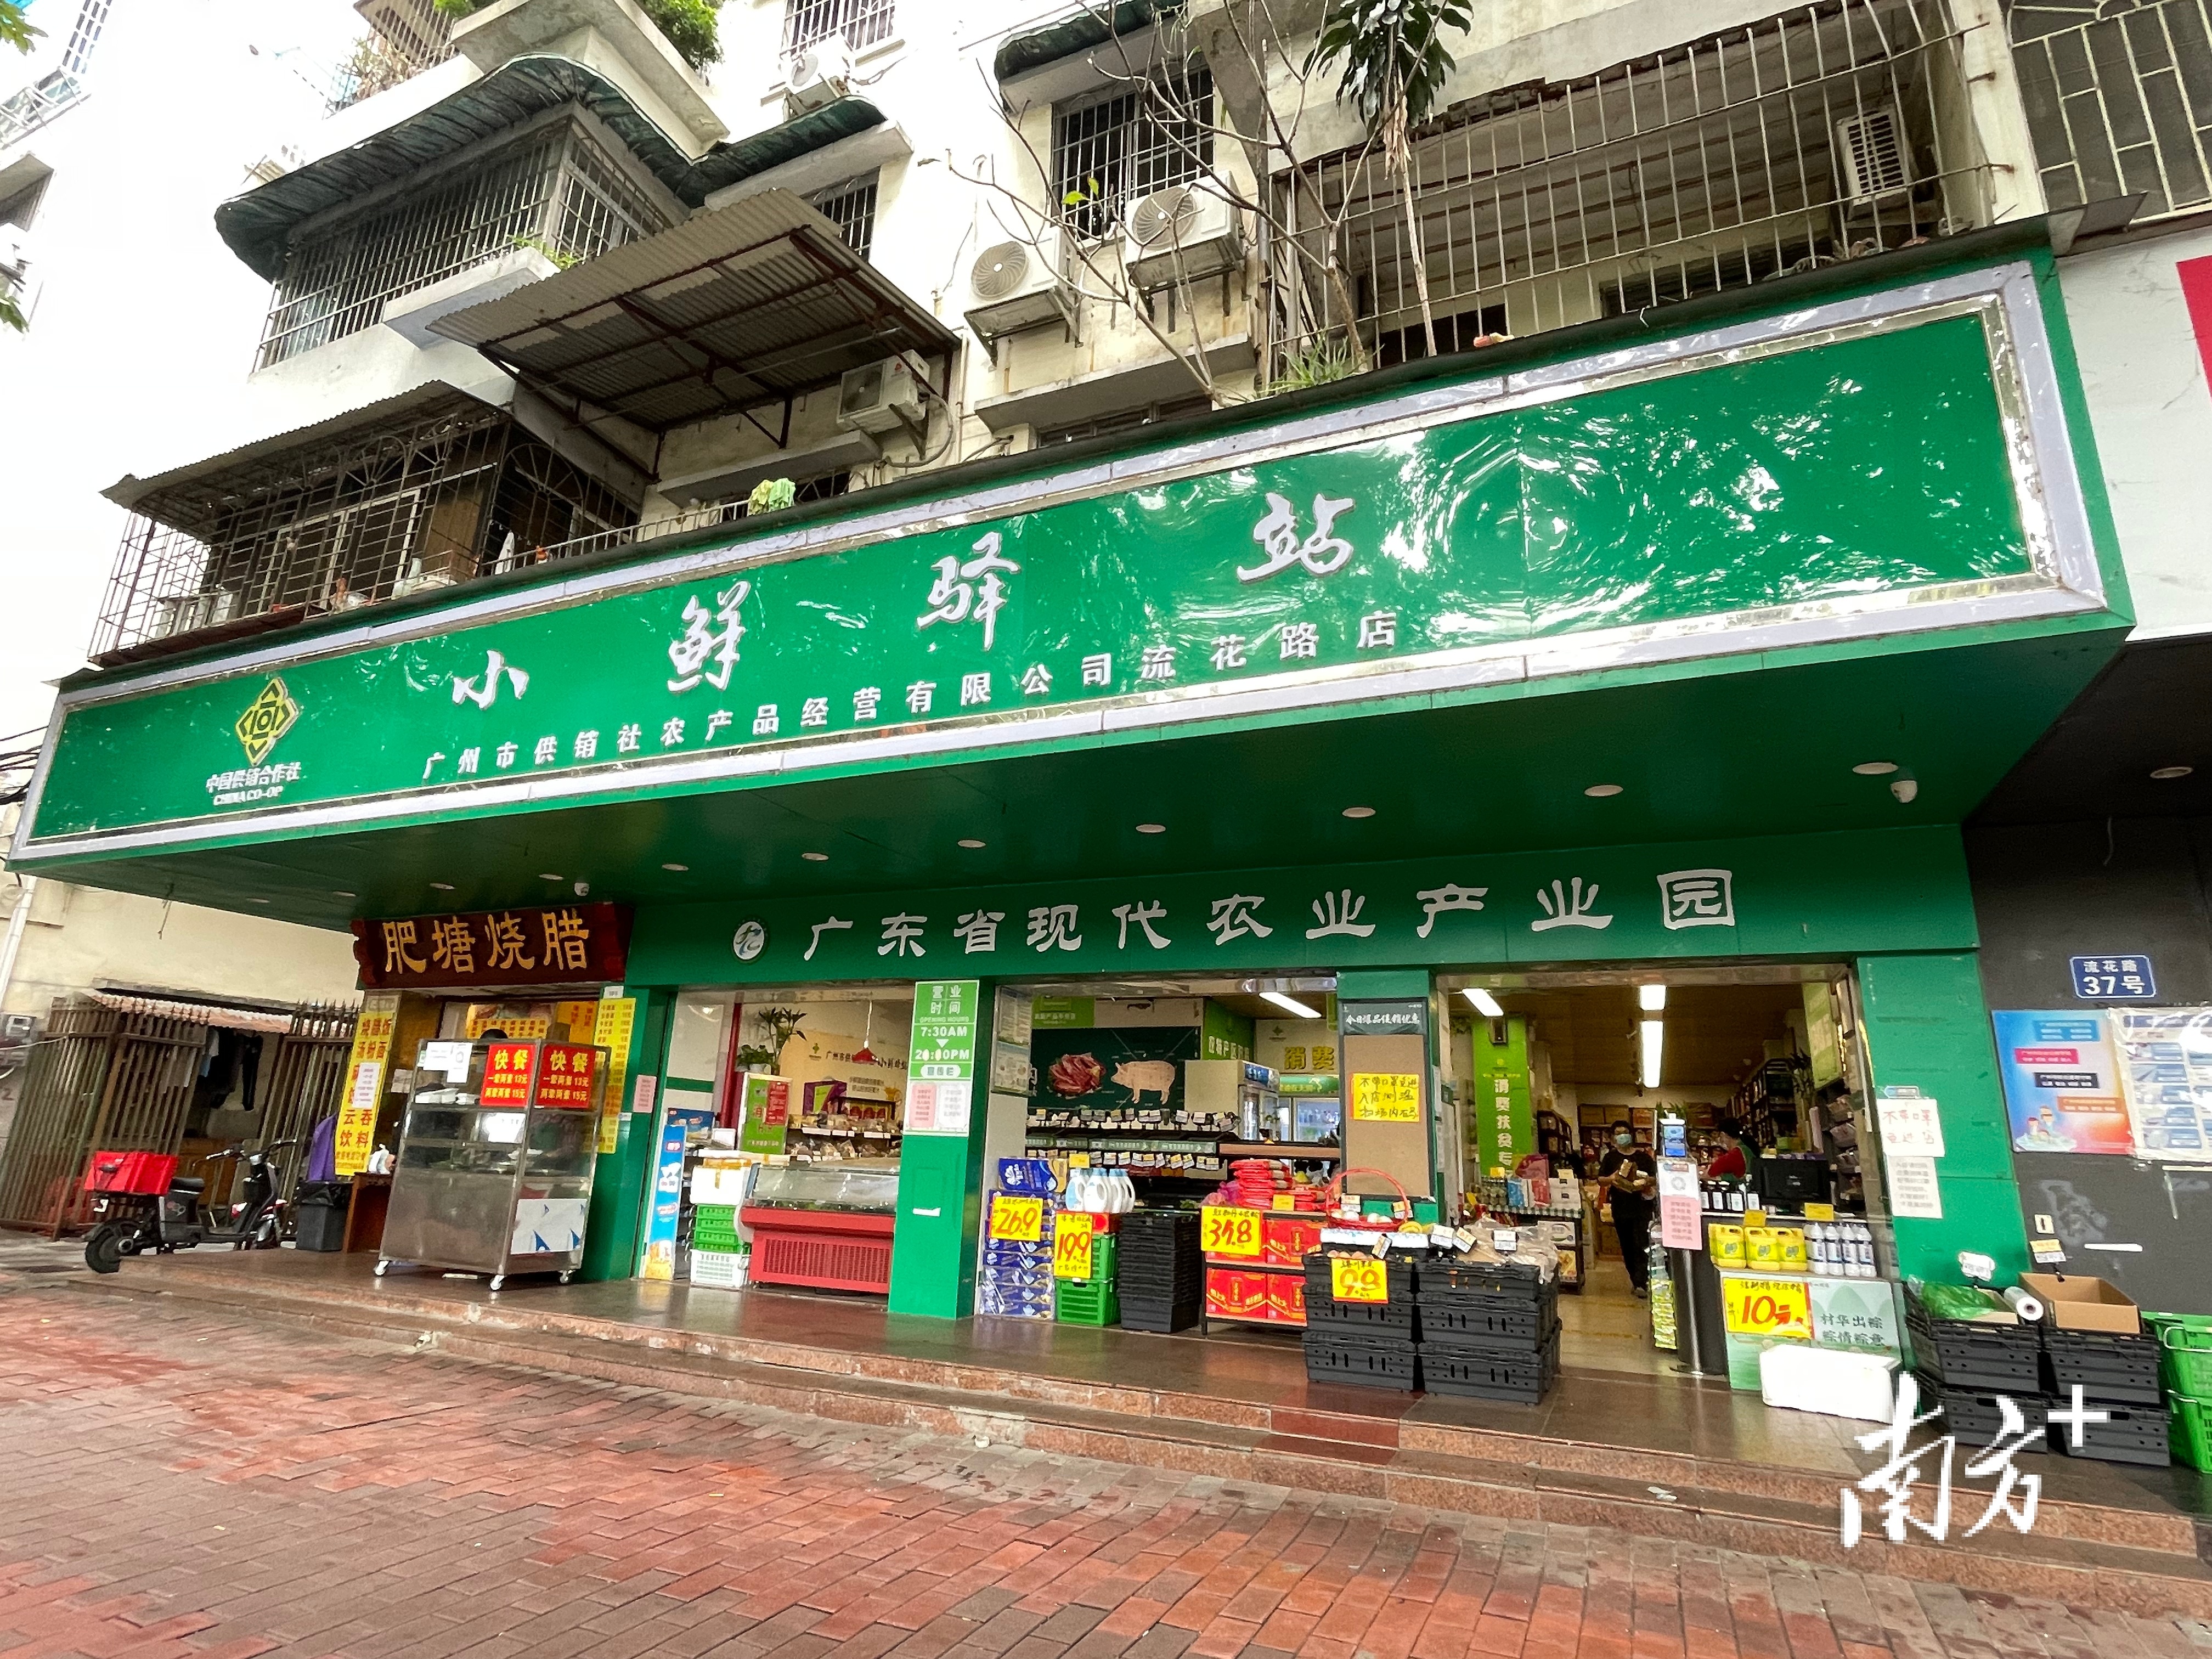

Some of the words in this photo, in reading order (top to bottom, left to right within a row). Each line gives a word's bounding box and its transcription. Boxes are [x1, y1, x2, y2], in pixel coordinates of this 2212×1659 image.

[452, 492, 1355, 710] 小鲜驿站
[422, 610, 1397, 780] 广州市供销社农产品经营有限公司流花路店
[803, 868, 1735, 961] 广东省现代农业产业园
[382, 909, 589, 975] 肥塘烧腊
[2084, 960, 2137, 973] 流花路
[932, 985, 961, 998] 营业
[2083, 975, 2145, 995] 37号
[930, 1001, 961, 1014] 时间
[921, 1026, 967, 1037] 7:30AM
[494, 1049, 529, 1070] 快餐
[550, 1050, 588, 1073] 快餐
[1284, 1046, 1335, 1070] 消费
[343, 1109, 373, 1126] 云吞
[340, 1130, 369, 1148] 饮料
[996, 1207, 1038, 1235] 26.9
